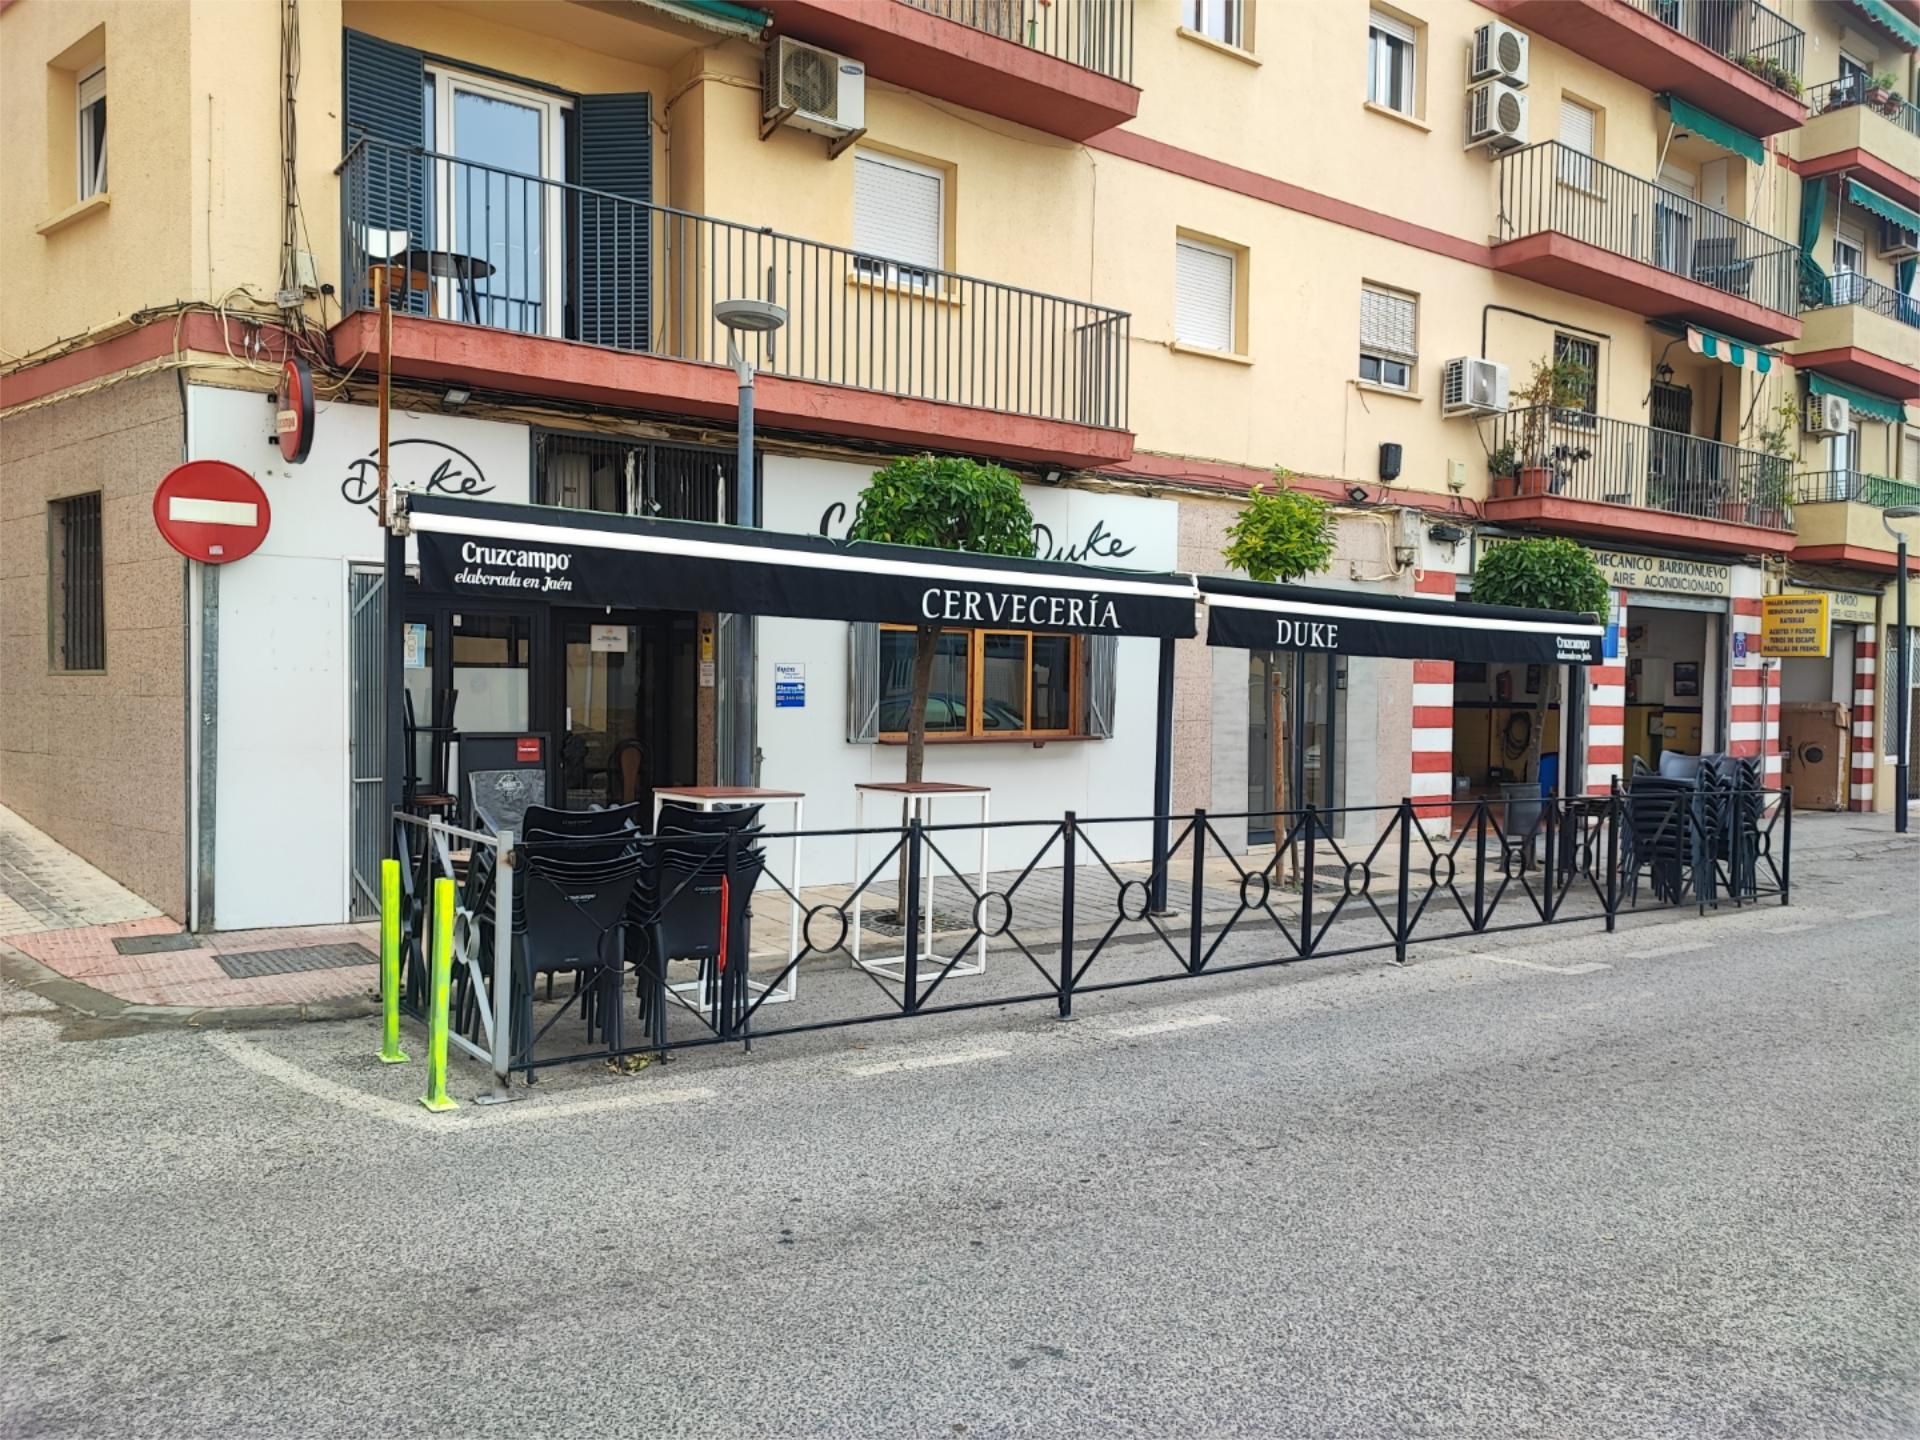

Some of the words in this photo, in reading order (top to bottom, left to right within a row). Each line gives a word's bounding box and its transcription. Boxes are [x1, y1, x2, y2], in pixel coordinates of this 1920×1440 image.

[341, 458, 496, 504] Dke
[1032, 520, 1137, 561] Duke
[462, 541, 569, 573] Cruzcampo
[1593, 552, 1652, 571] MECANICO
[1658, 559, 1728, 580] BARRIONUEVO
[454, 567, 522, 588] elaborada
[522, 576, 540, 589] en
[541, 575, 573, 592] Jaén
[1612, 571, 1636, 586] AIRE
[1644, 575, 1724, 594] ACONDICIONADO
[922, 588, 1121, 628] CERVECERÍA
[1277, 619, 1338, 648] DUKE
